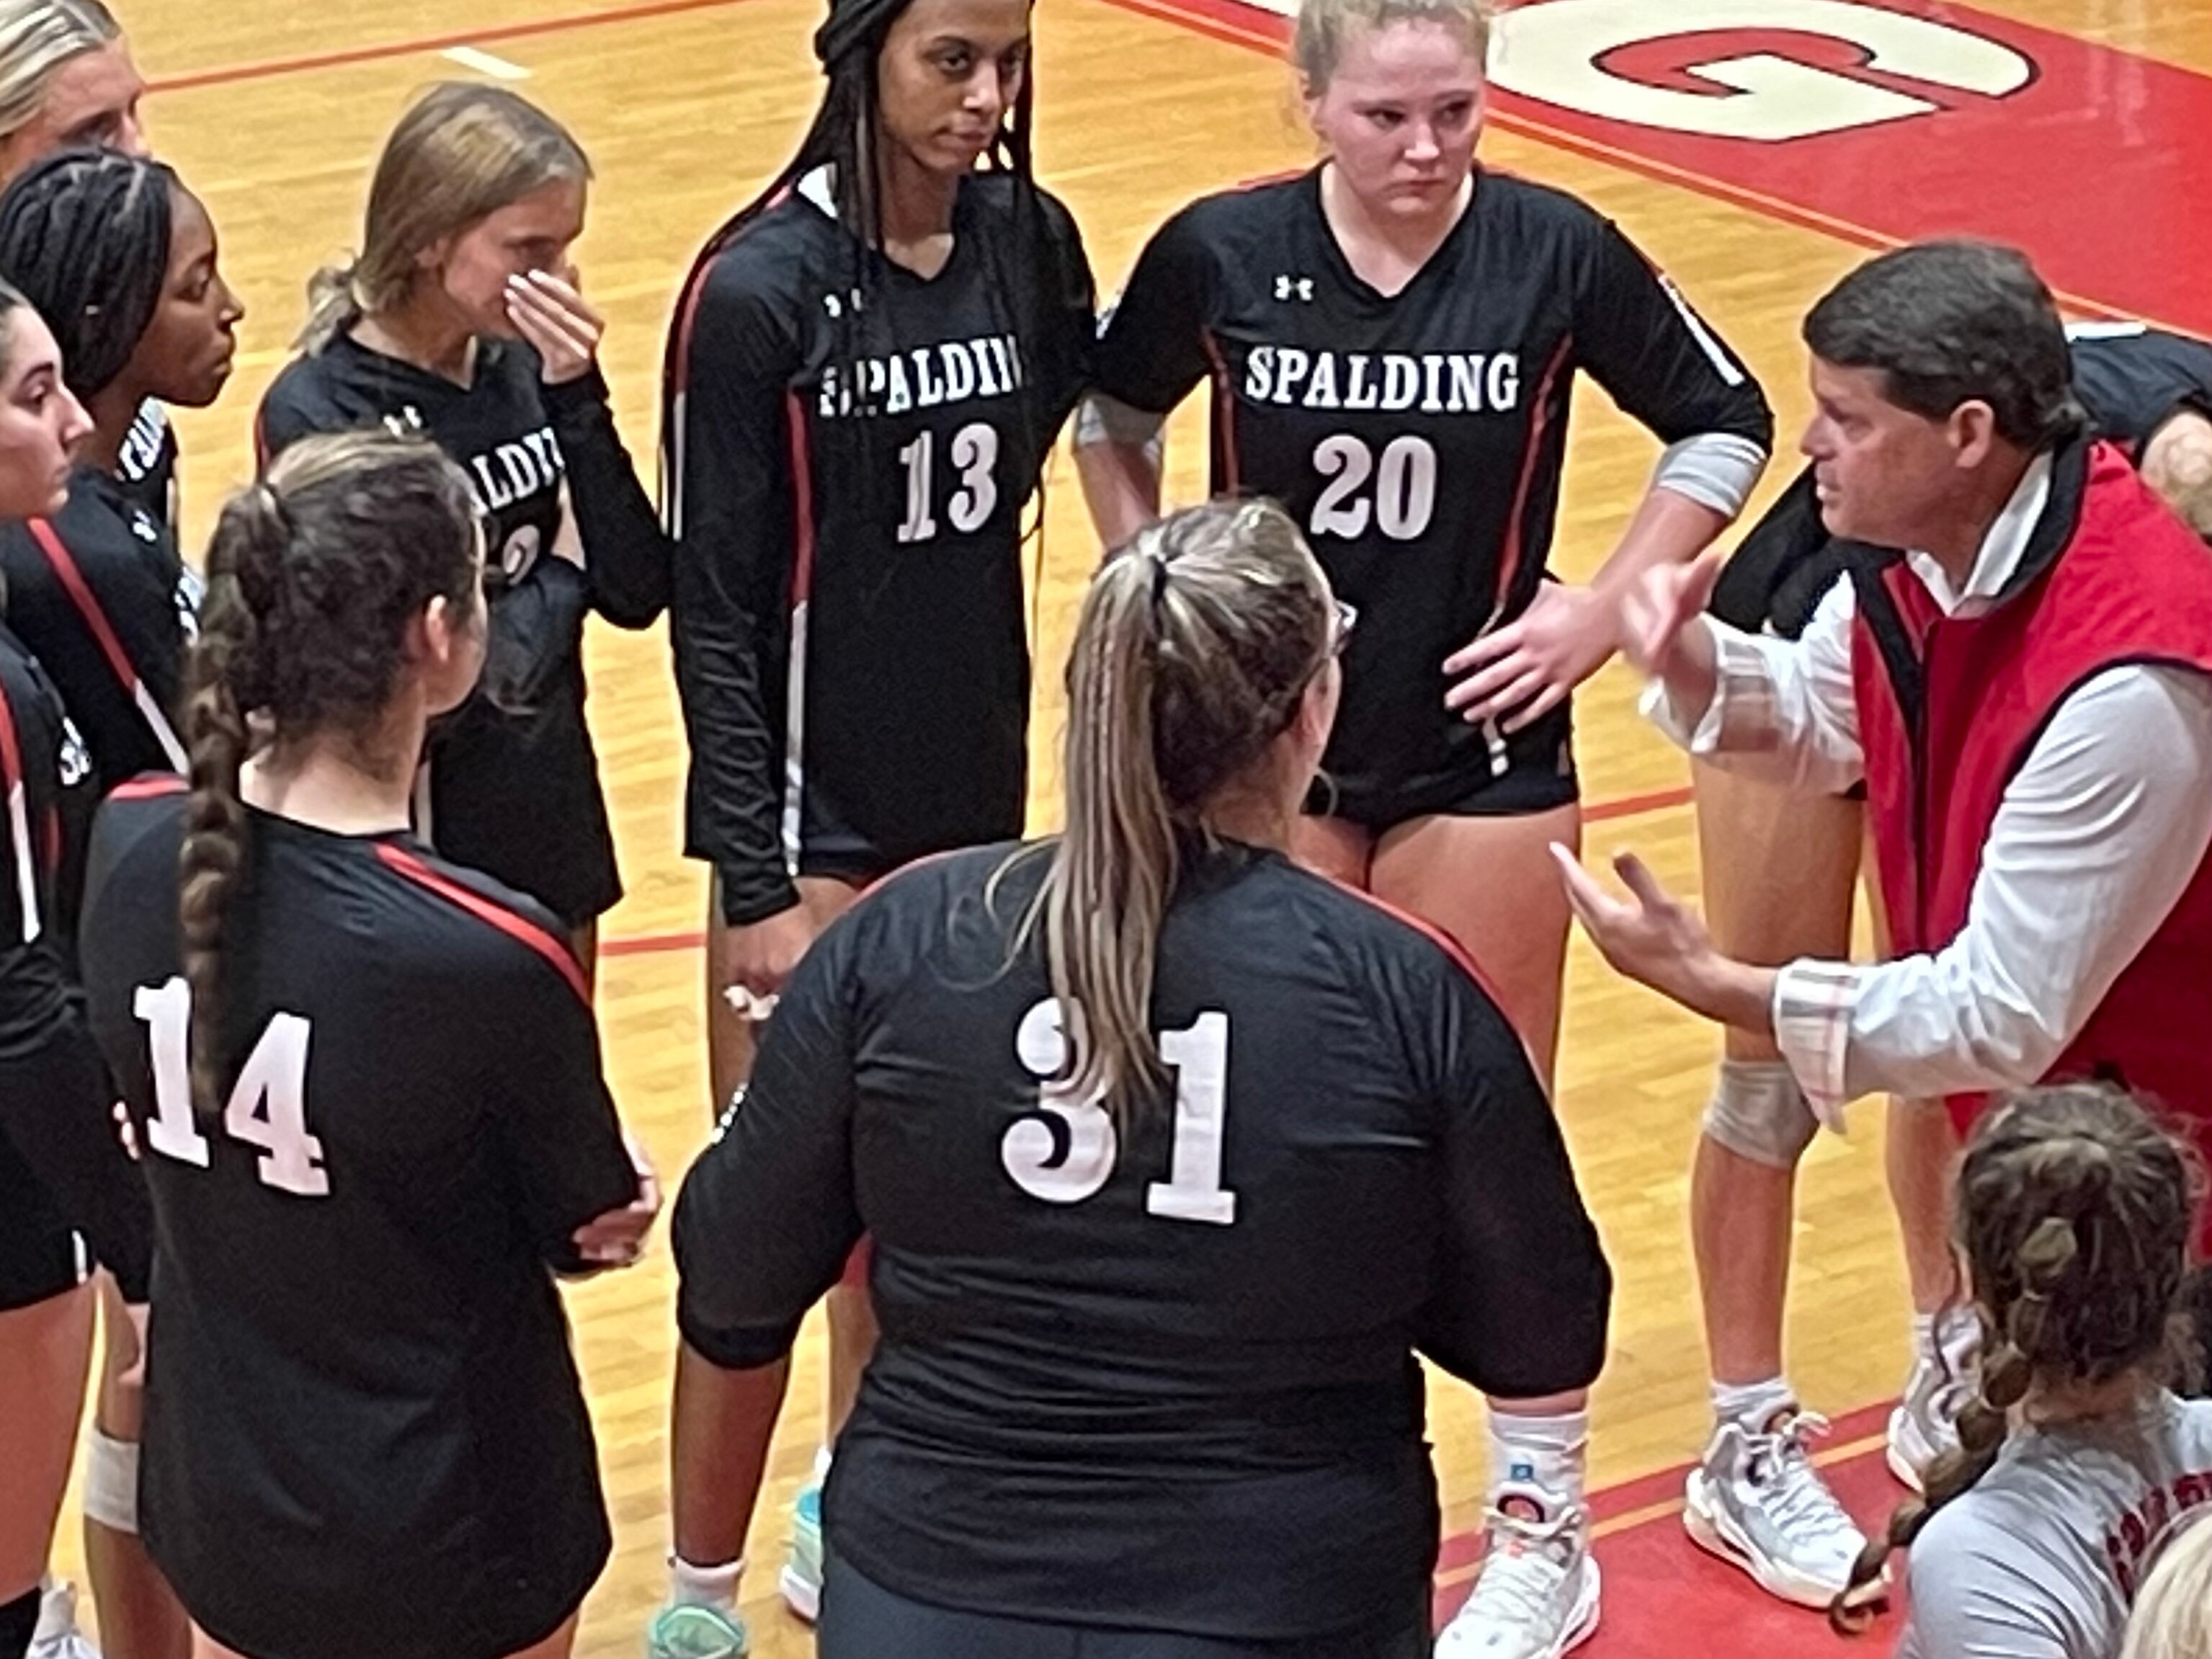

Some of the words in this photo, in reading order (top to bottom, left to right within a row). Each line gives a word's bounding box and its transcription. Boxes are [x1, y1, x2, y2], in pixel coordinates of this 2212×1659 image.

[1486, 0, 2039, 143] G
[1245, 346, 1520, 412] SPALDING
[898, 422, 997, 542] 13
[1310, 435, 1437, 541] 20
[133, 976, 329, 1196] 14
[1001, 996, 1236, 1224] 31
